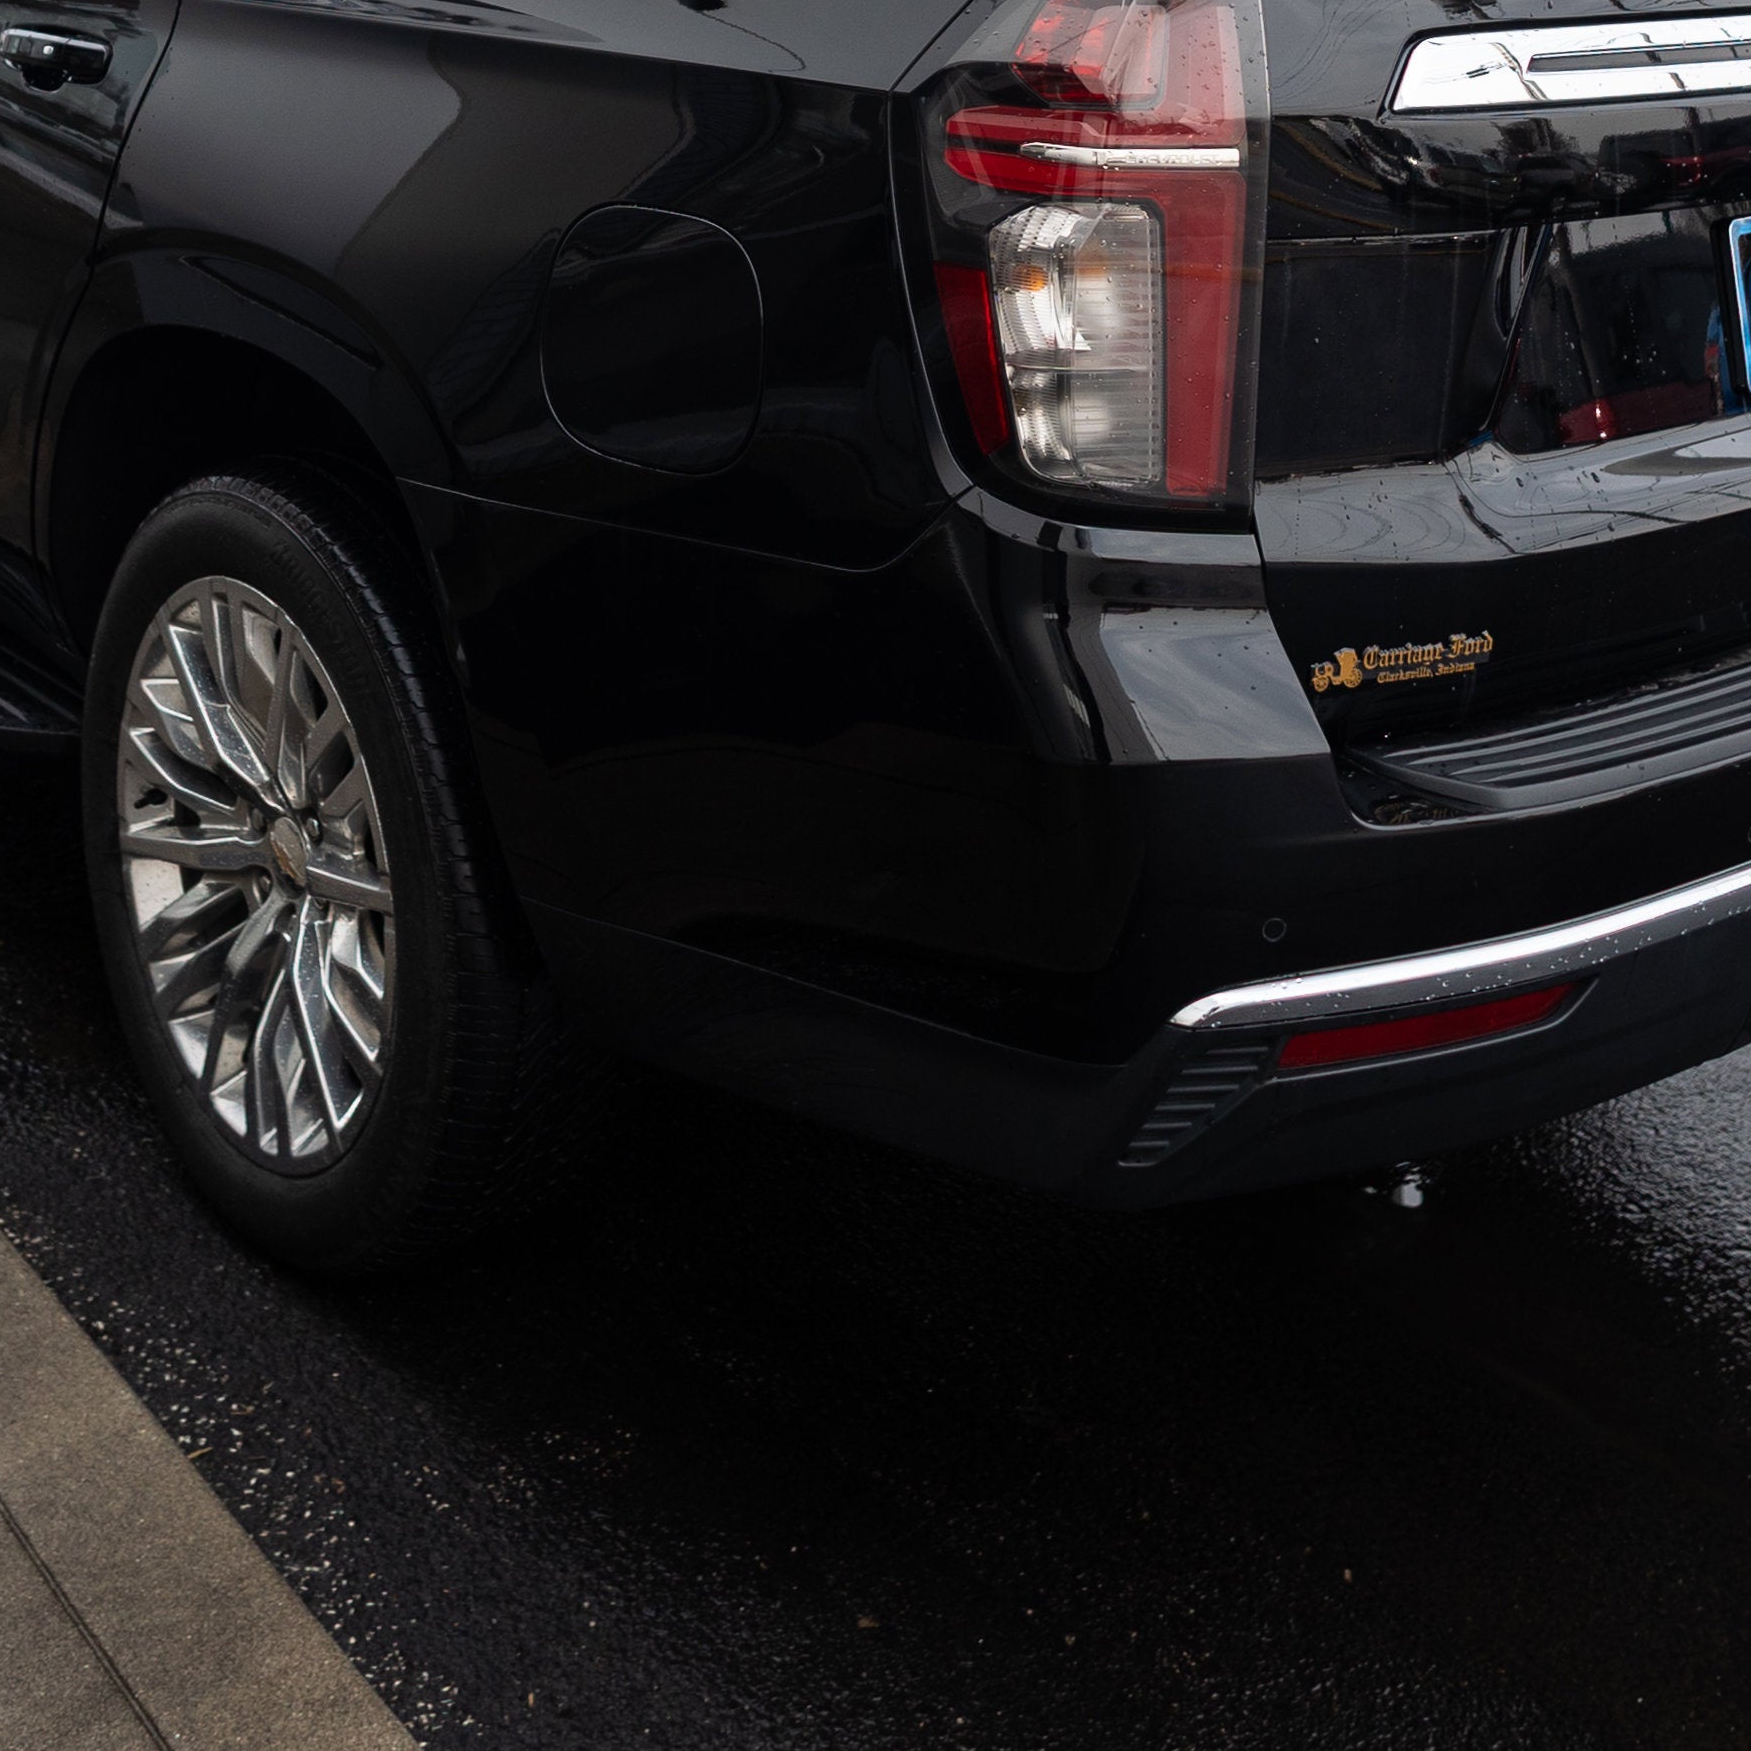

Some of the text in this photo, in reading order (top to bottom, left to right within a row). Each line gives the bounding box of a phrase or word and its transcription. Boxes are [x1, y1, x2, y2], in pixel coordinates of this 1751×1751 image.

[1363, 629, 1494, 669] Carriage Ford
[1436, 661, 1476, 677] Indiana
